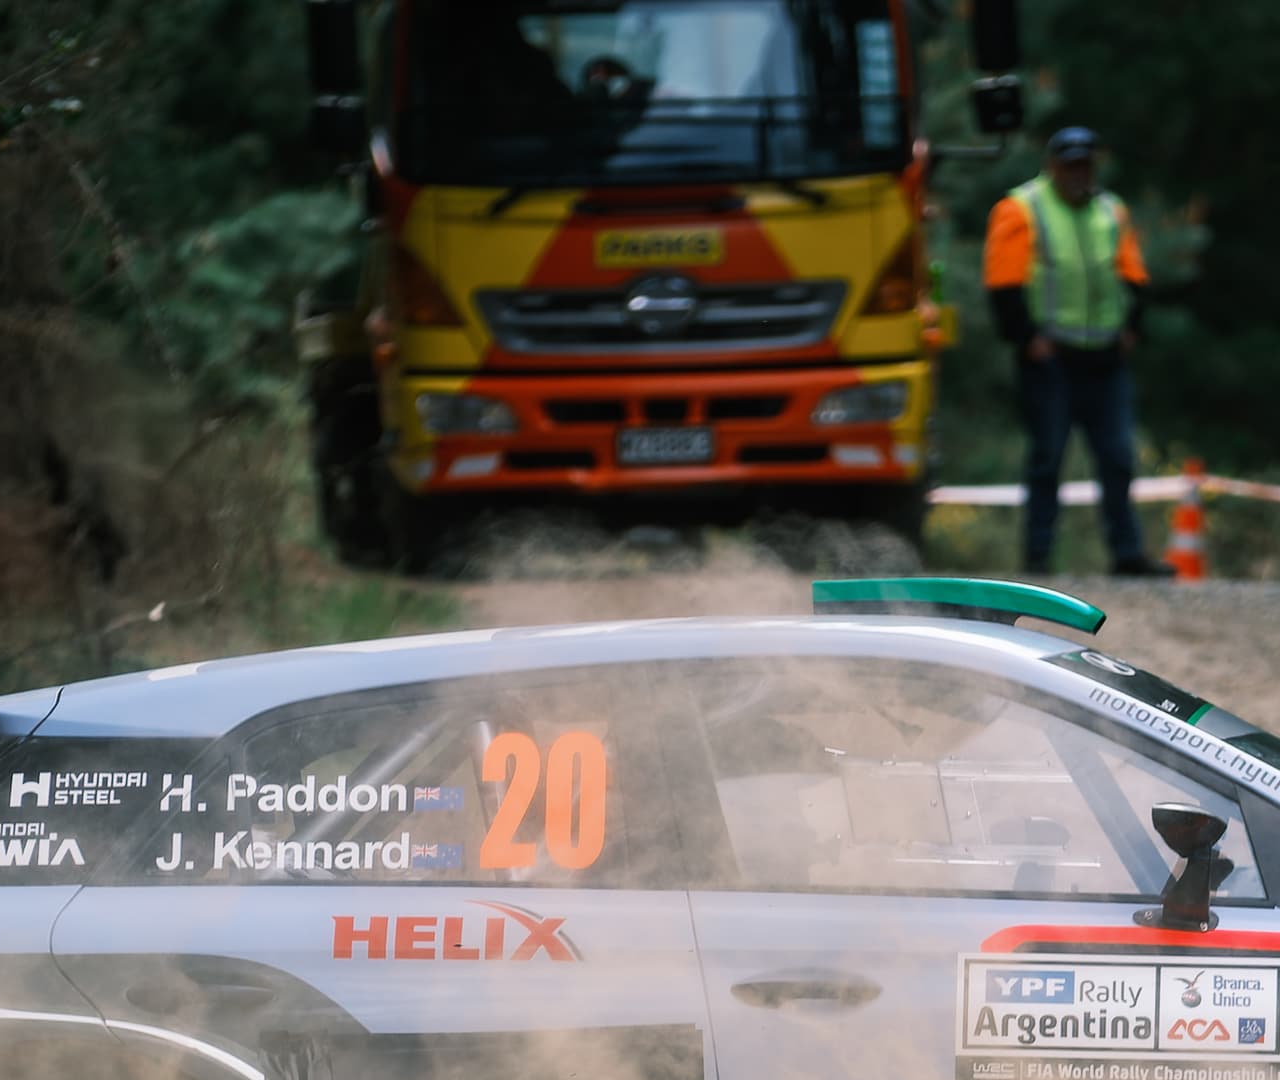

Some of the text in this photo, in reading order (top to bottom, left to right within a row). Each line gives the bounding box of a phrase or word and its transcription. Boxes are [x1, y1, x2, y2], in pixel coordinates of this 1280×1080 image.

[55, 771, 148, 788] HYUNDAI
[159, 773, 407, 813] H. Paddon
[54, 789, 121, 805] STEEL
[480, 731, 607, 869] 20
[155, 831, 410, 871] J. Kennard
[332, 902, 582, 962] HELIX
[992, 977, 1144, 1008] YPF Rally
[1212, 992, 1252, 1008] Unico
[973, 1006, 1152, 1044] Argentina
[1027, 1064, 1054, 1079] FIA
[1058, 1064, 1105, 1080] World
